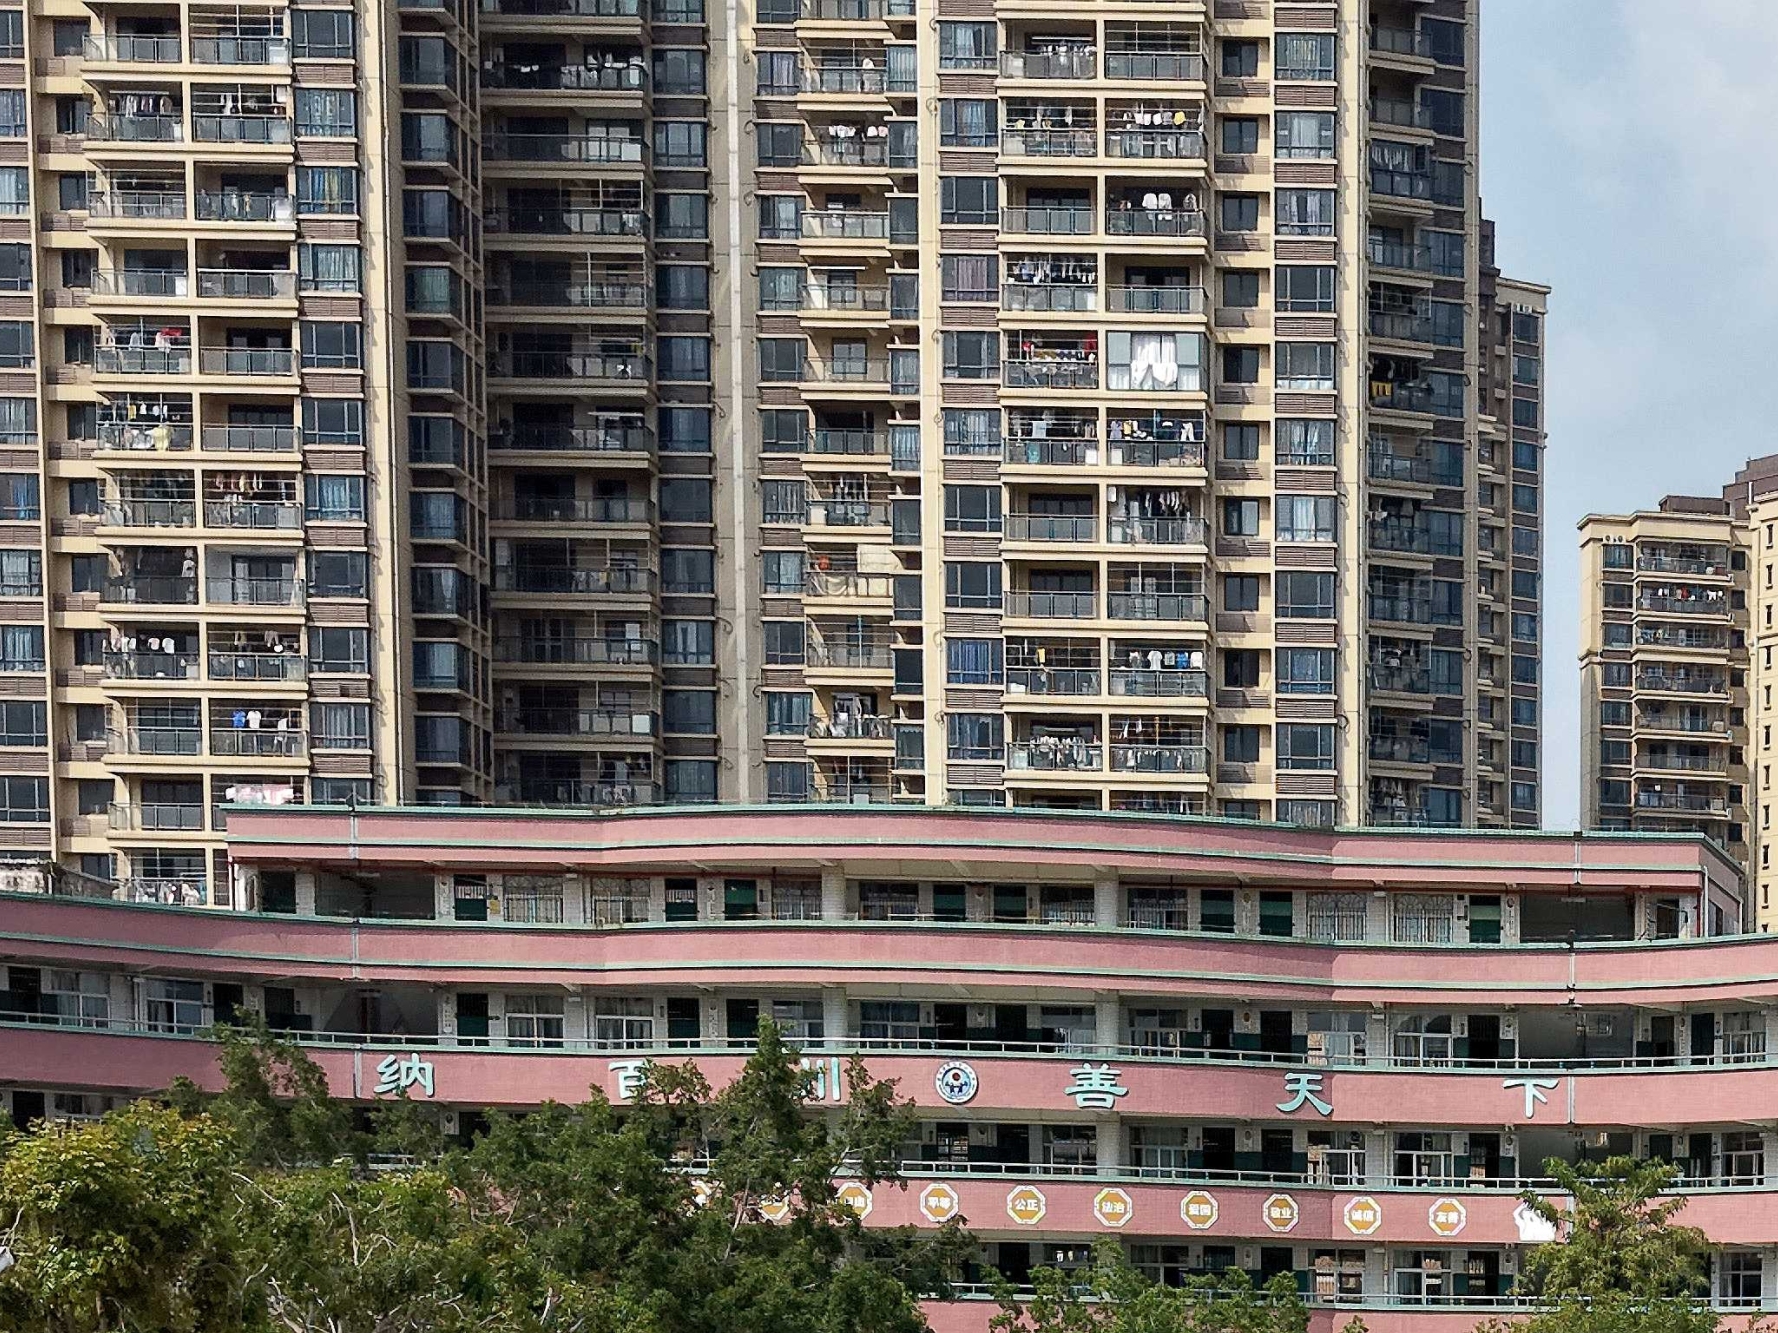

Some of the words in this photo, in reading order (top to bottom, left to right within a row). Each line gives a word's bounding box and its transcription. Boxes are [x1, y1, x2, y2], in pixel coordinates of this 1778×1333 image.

[1014, 1199, 1038, 1211] 公正
[1101, 1202, 1125, 1214] 法治
[1189, 1204, 1211, 1216] 爱国
[1271, 1207, 1292, 1219] 敬业
[1351, 1208, 1374, 1221] 诚信
[1436, 1211, 1458, 1224] 友善
